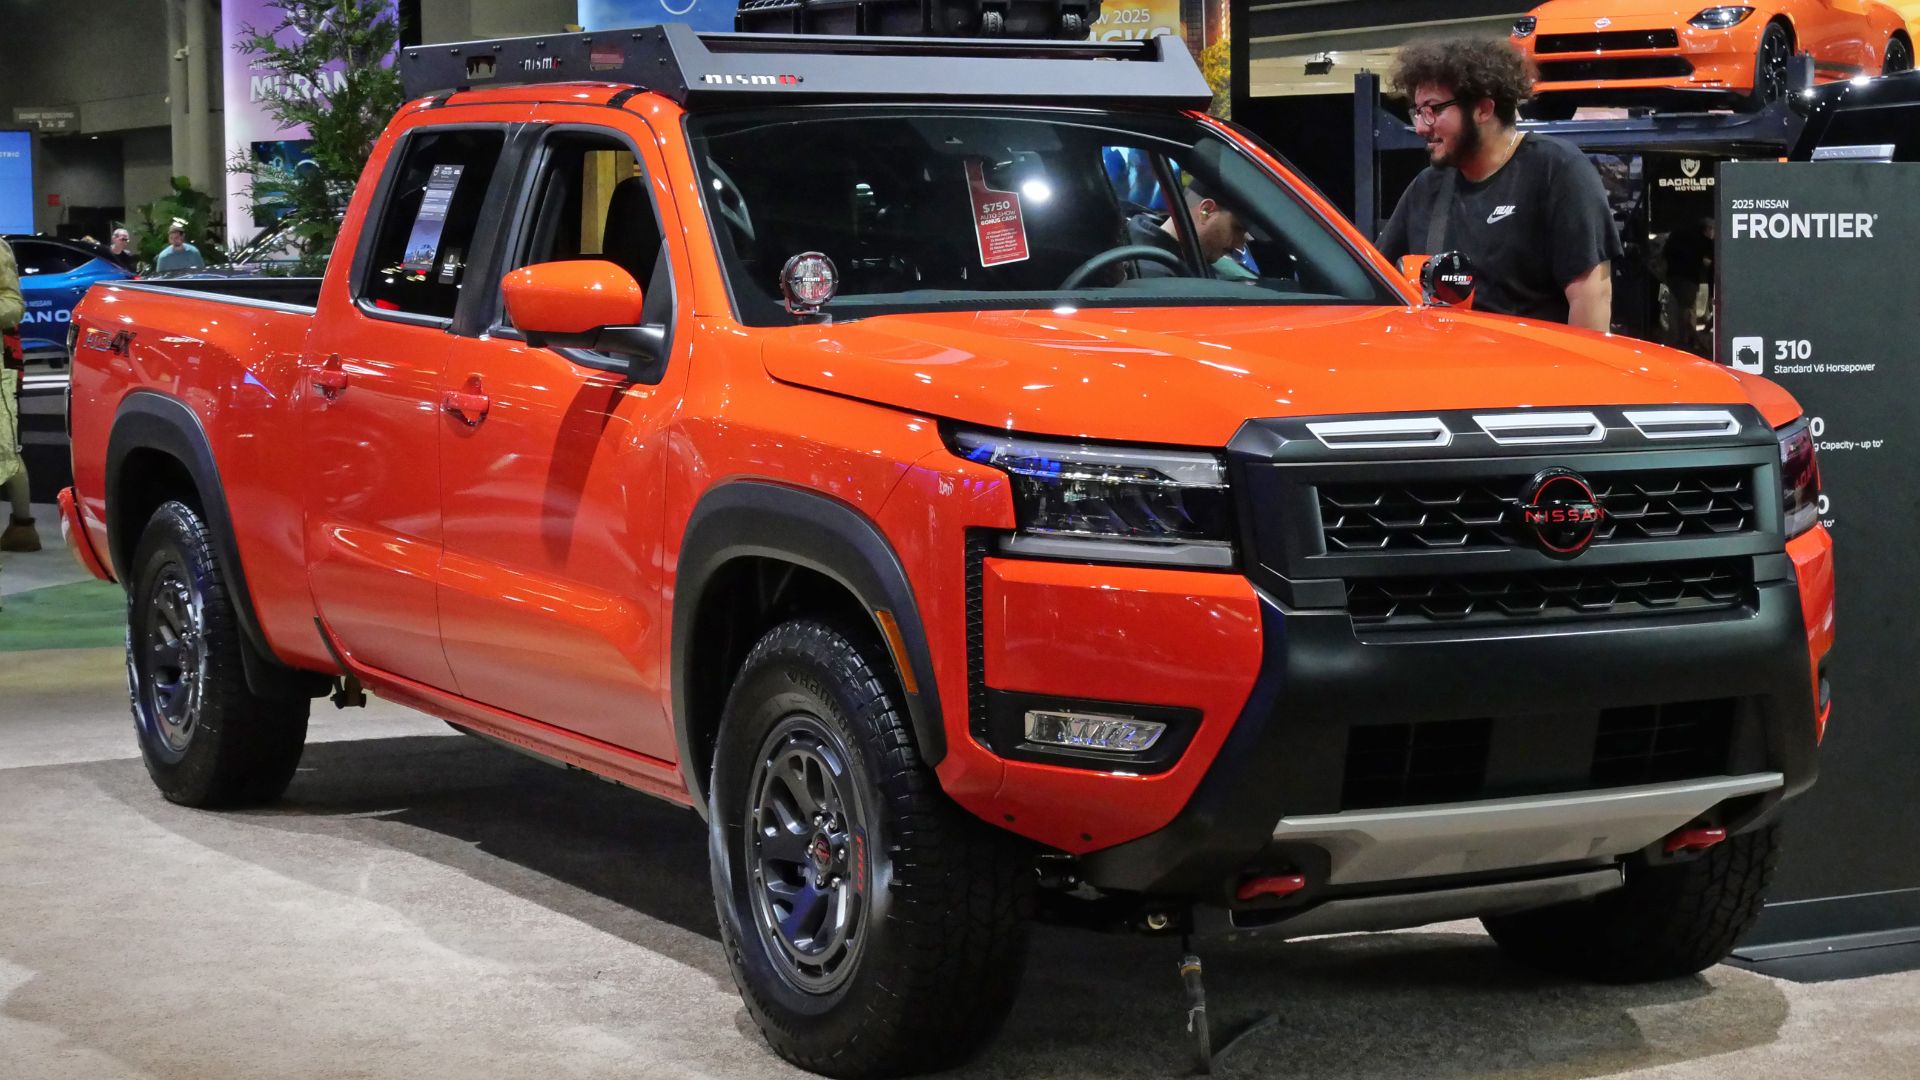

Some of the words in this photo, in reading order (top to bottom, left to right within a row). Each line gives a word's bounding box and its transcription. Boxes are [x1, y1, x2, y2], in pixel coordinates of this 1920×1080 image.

[1113, 8, 1151, 24] 2025
[250, 70, 349, 101] MURAN
[1658, 177, 1715, 187] SACRILEG
[982, 200, 1011, 214] $750
[1732, 199, 1754, 209] 2025
[1756, 199, 1789, 209] NISSAN
[980, 218, 1001, 226] BONUS
[1001, 214, 1017, 222] CASH
[20, 309, 71, 324] ANO
[1775, 339, 1812, 360] 310
[1774, 363, 1812, 374] Standard
[1813, 363, 1824, 373] V6
[1826, 362, 1875, 374] Horsepower
[1820, 441, 1854, 451] Capacity
[1860, 440, 1872, 450] up
[1524, 508, 1605, 523] NISSAN
